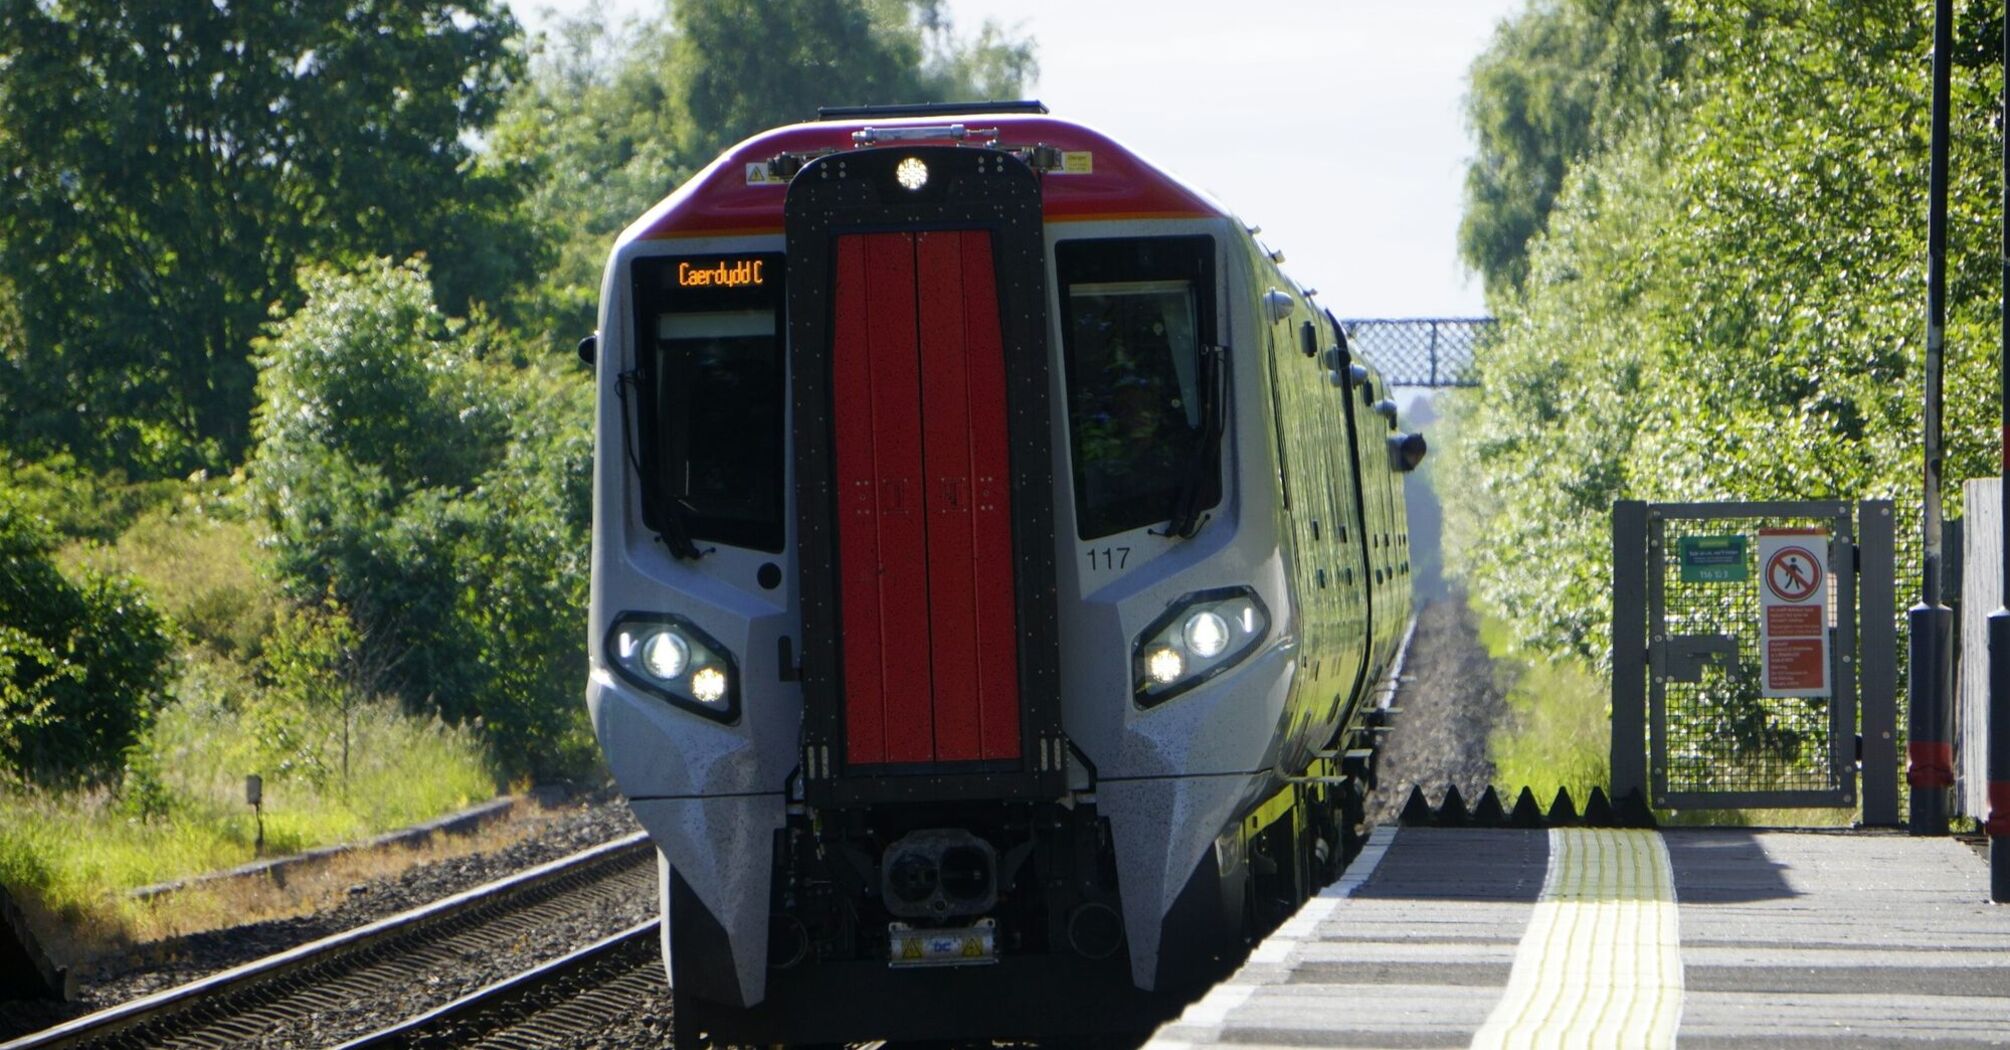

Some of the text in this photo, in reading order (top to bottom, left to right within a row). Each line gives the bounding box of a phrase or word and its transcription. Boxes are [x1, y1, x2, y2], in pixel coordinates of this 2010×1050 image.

[679, 260, 763, 287] Caerdydd C
[1086, 547, 1130, 571] 117
